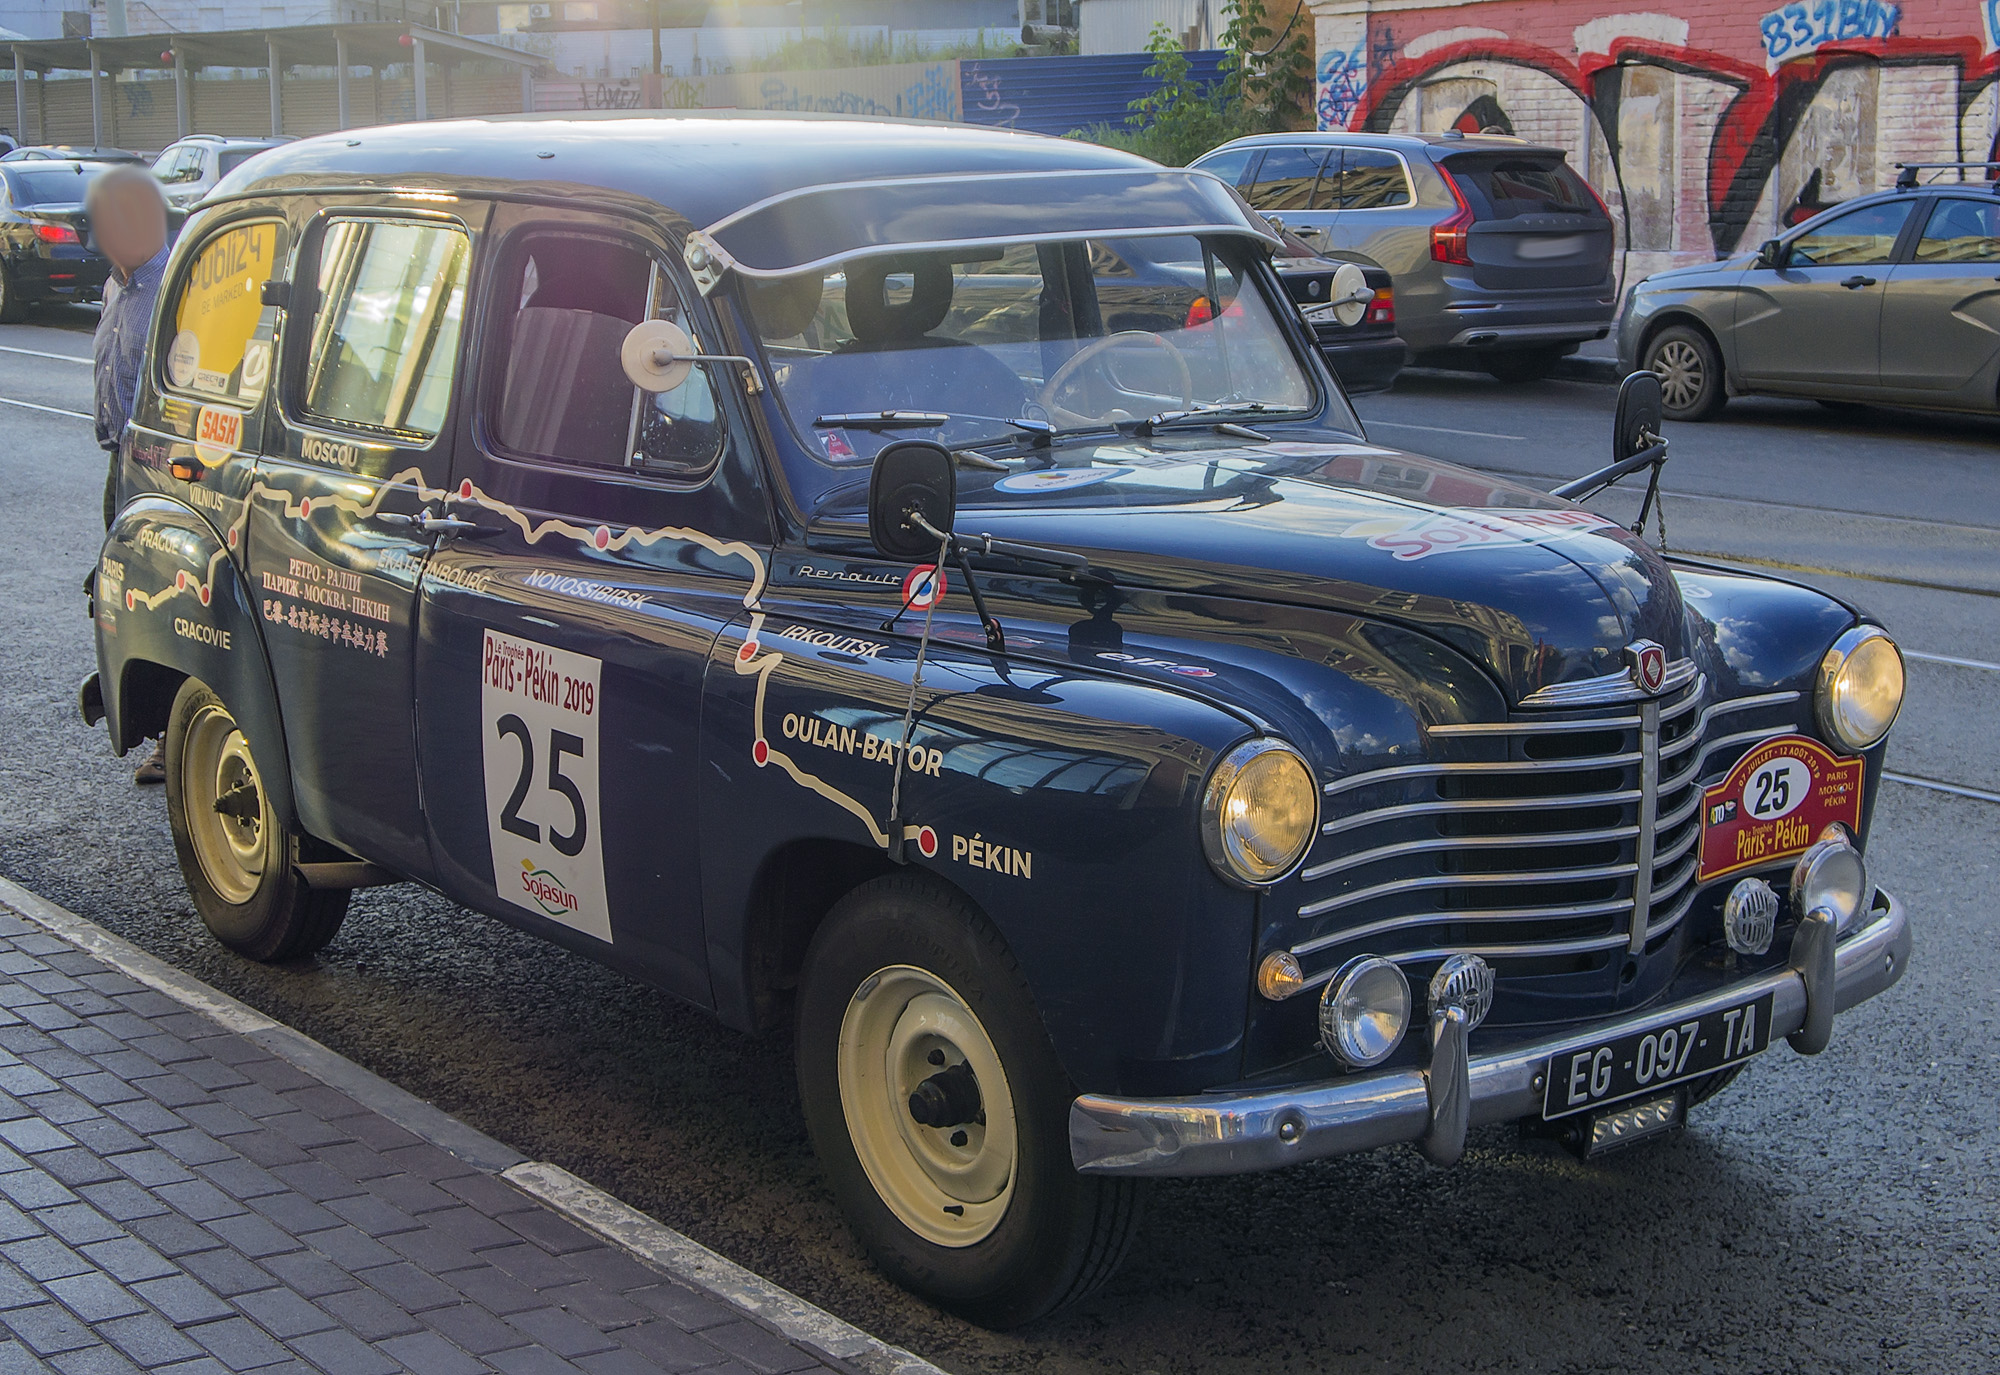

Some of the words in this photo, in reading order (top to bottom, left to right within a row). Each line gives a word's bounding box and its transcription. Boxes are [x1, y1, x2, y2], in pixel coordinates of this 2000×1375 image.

[201, 410, 239, 445] SASH
[300, 438, 358, 467] MOSCOU
[189, 485, 224, 512] VILNIUS
[140, 529, 179, 555] PRAGUE
[102, 557, 125, 580] PARIS
[289, 558, 320, 582] РЕТРО
[326, 568, 361, 593] РАЛЛИ
[798, 565, 902, 586] Renault
[524, 568, 653, 611] NOVOSSIBIRSK
[174, 617, 232, 650] CRACOVIE
[494, 638, 502, 654] Le
[502, 640, 524, 661] Trophée
[778, 624, 890, 659] IRKOUTSK
[484, 635, 515, 693] Paris
[525, 646, 559, 707] Pékin
[563, 676, 594, 716] 2019
[1738, 774, 1747, 787] 07
[1748, 749, 1773, 773] JUILLET
[1780, 746, 1788, 755] 12
[1826, 770, 1848, 782] PARIS
[496, 713, 587, 857] 25
[1753, 767, 1790, 816] 25
[1818, 782, 1854, 796] MOSCOU
[1824, 795, 1847, 808] PÉKIN
[1737, 829, 1765, 861] Paris
[1775, 815, 1810, 850] Pékin
[952, 832, 1032, 880] PÉKIN
[521, 870, 579, 912] Sojasun
[1723, 1003, 1756, 1060] TA
